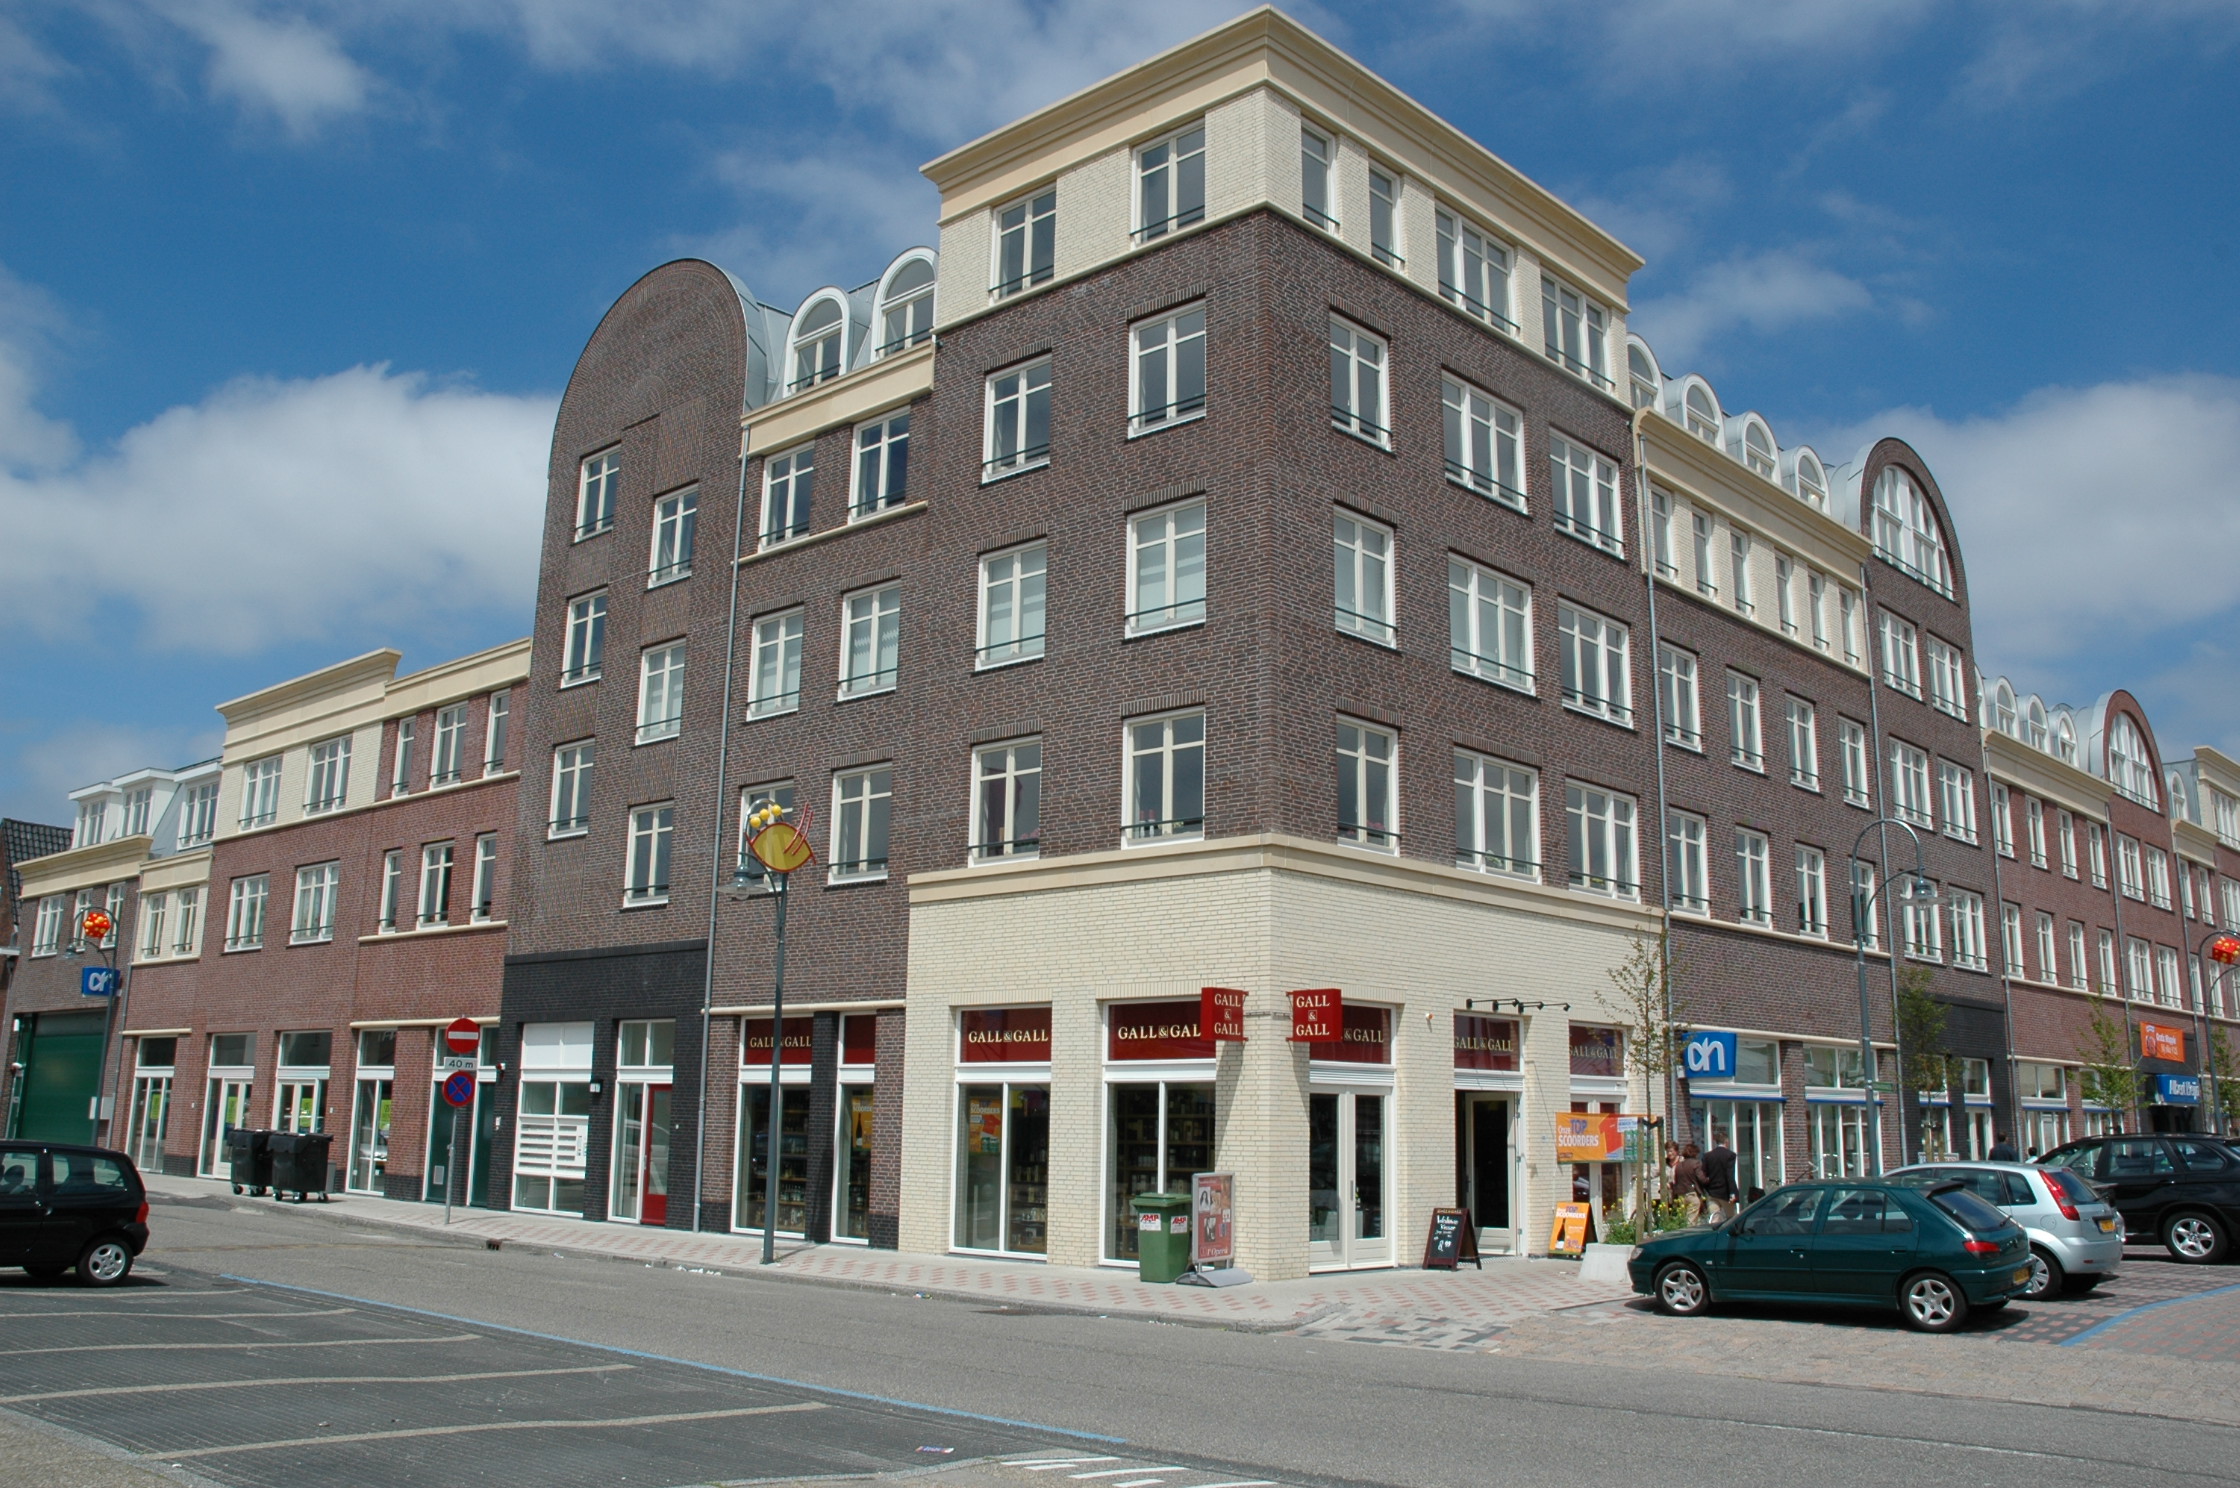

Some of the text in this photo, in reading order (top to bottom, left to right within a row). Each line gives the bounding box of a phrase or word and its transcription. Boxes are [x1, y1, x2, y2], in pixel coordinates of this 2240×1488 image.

[1214, 993, 1241, 1007] GALL
[1296, 995, 1330, 1008] GALL
[1224, 1009, 1231, 1020] &
[1308, 1010, 1317, 1021] &
[1214, 1022, 1241, 1035] GALL
[1296, 1024, 1330, 1036] GALL
[448, 1059, 474, 1069] 40 m
[1570, 1118, 1588, 1135] TOP
[1558, 1134, 1599, 1147] SCOORDERS
